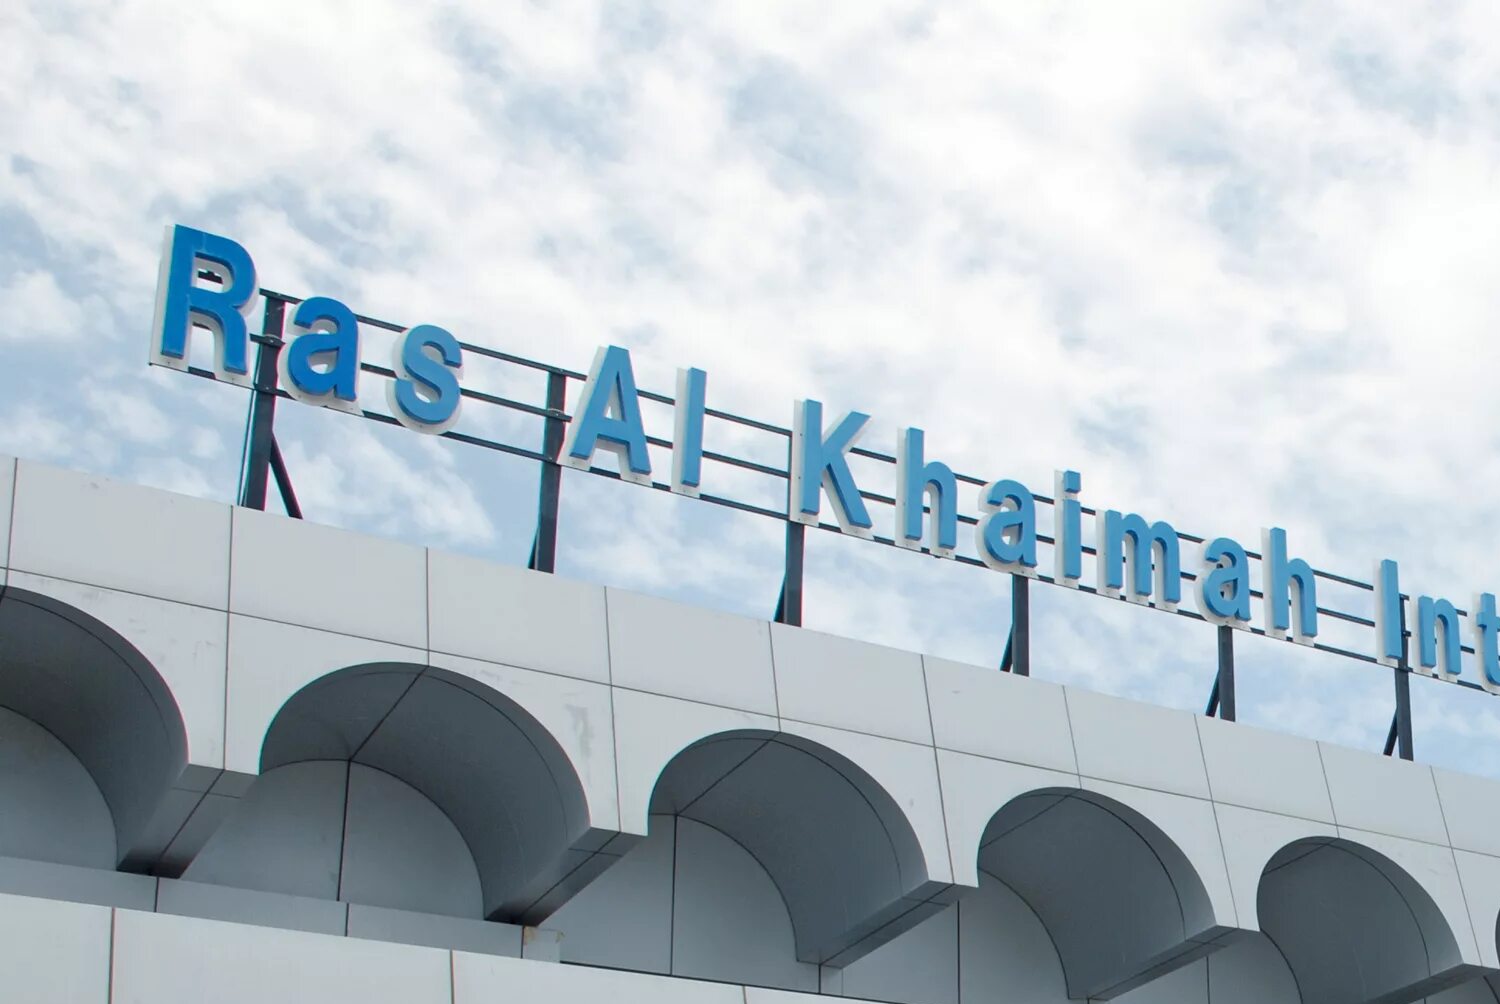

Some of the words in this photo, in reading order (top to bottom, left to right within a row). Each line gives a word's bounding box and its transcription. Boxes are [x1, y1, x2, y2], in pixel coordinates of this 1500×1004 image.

[153, 224, 462, 434] Ras
[559, 345, 706, 498] Al
[792, 398, 1319, 644] Khaimah
